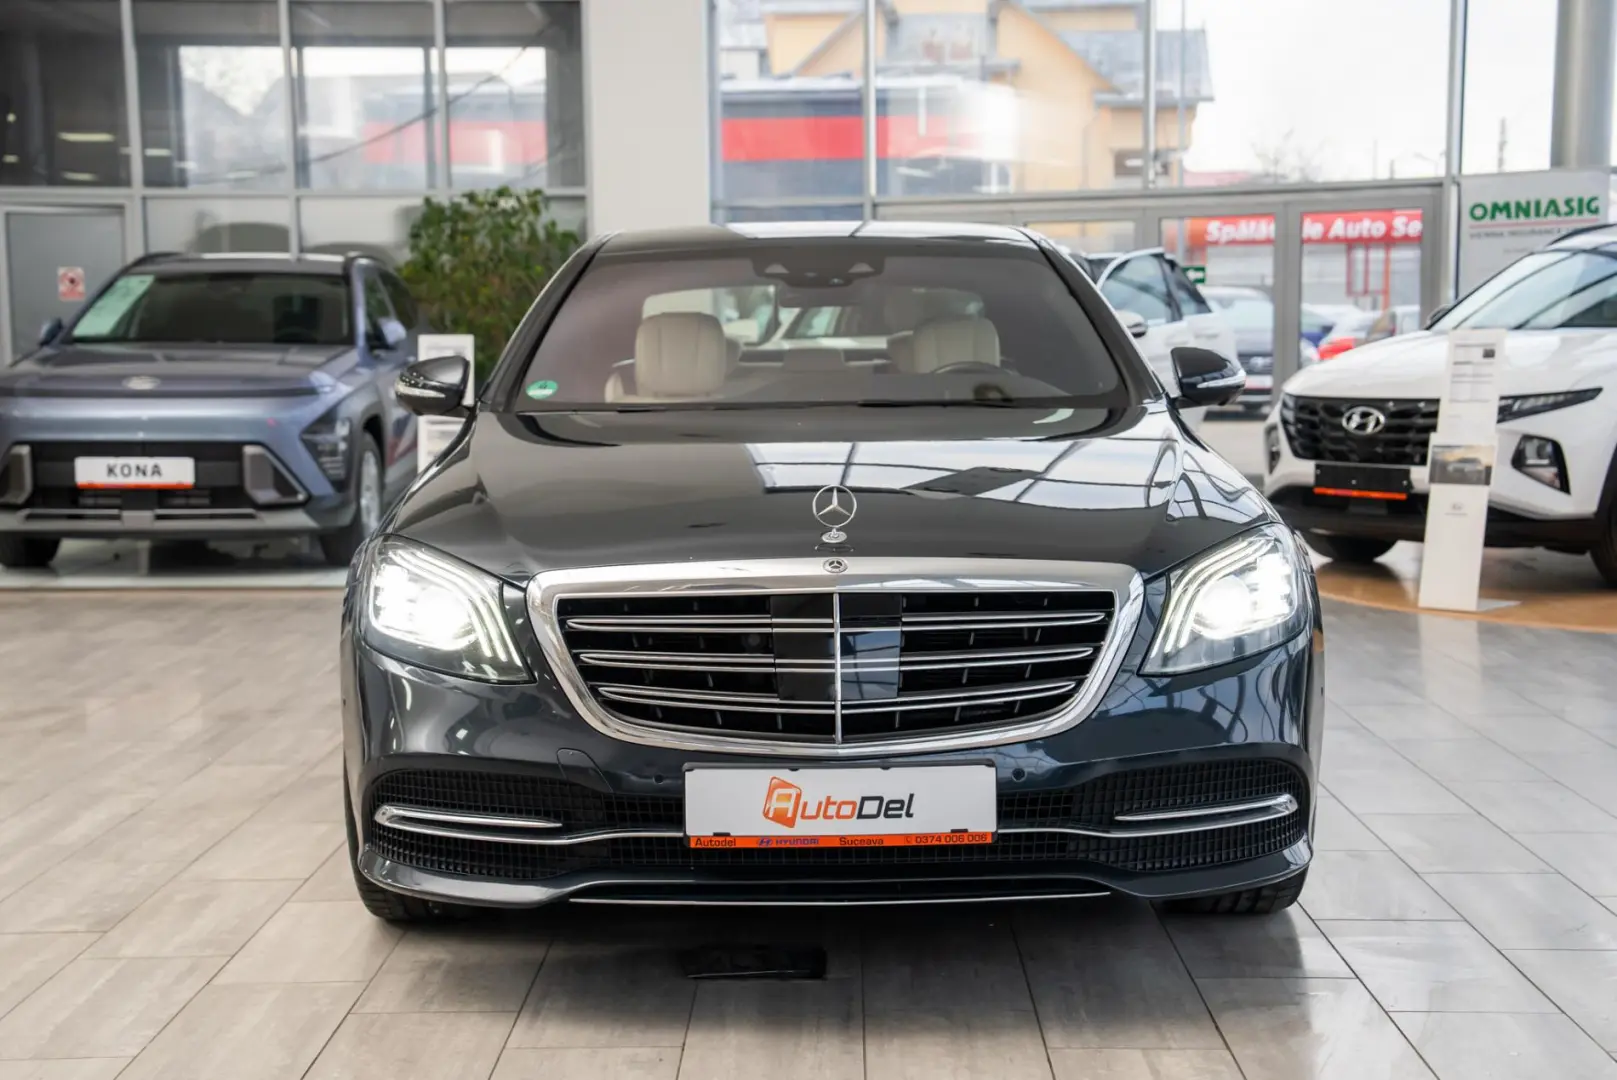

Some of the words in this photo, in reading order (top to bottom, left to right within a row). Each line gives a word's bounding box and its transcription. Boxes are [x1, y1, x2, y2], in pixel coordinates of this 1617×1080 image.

[1469, 196, 1600, 221] OMNIASIG
[1327, 217, 1386, 239] Auto
[106, 463, 162, 478] KONA
[764, 784, 915, 823] AutoDel
[695, 837, 736, 847] Autodel
[839, 836, 884, 846] Suceava
[915, 834, 942, 844] 0374
